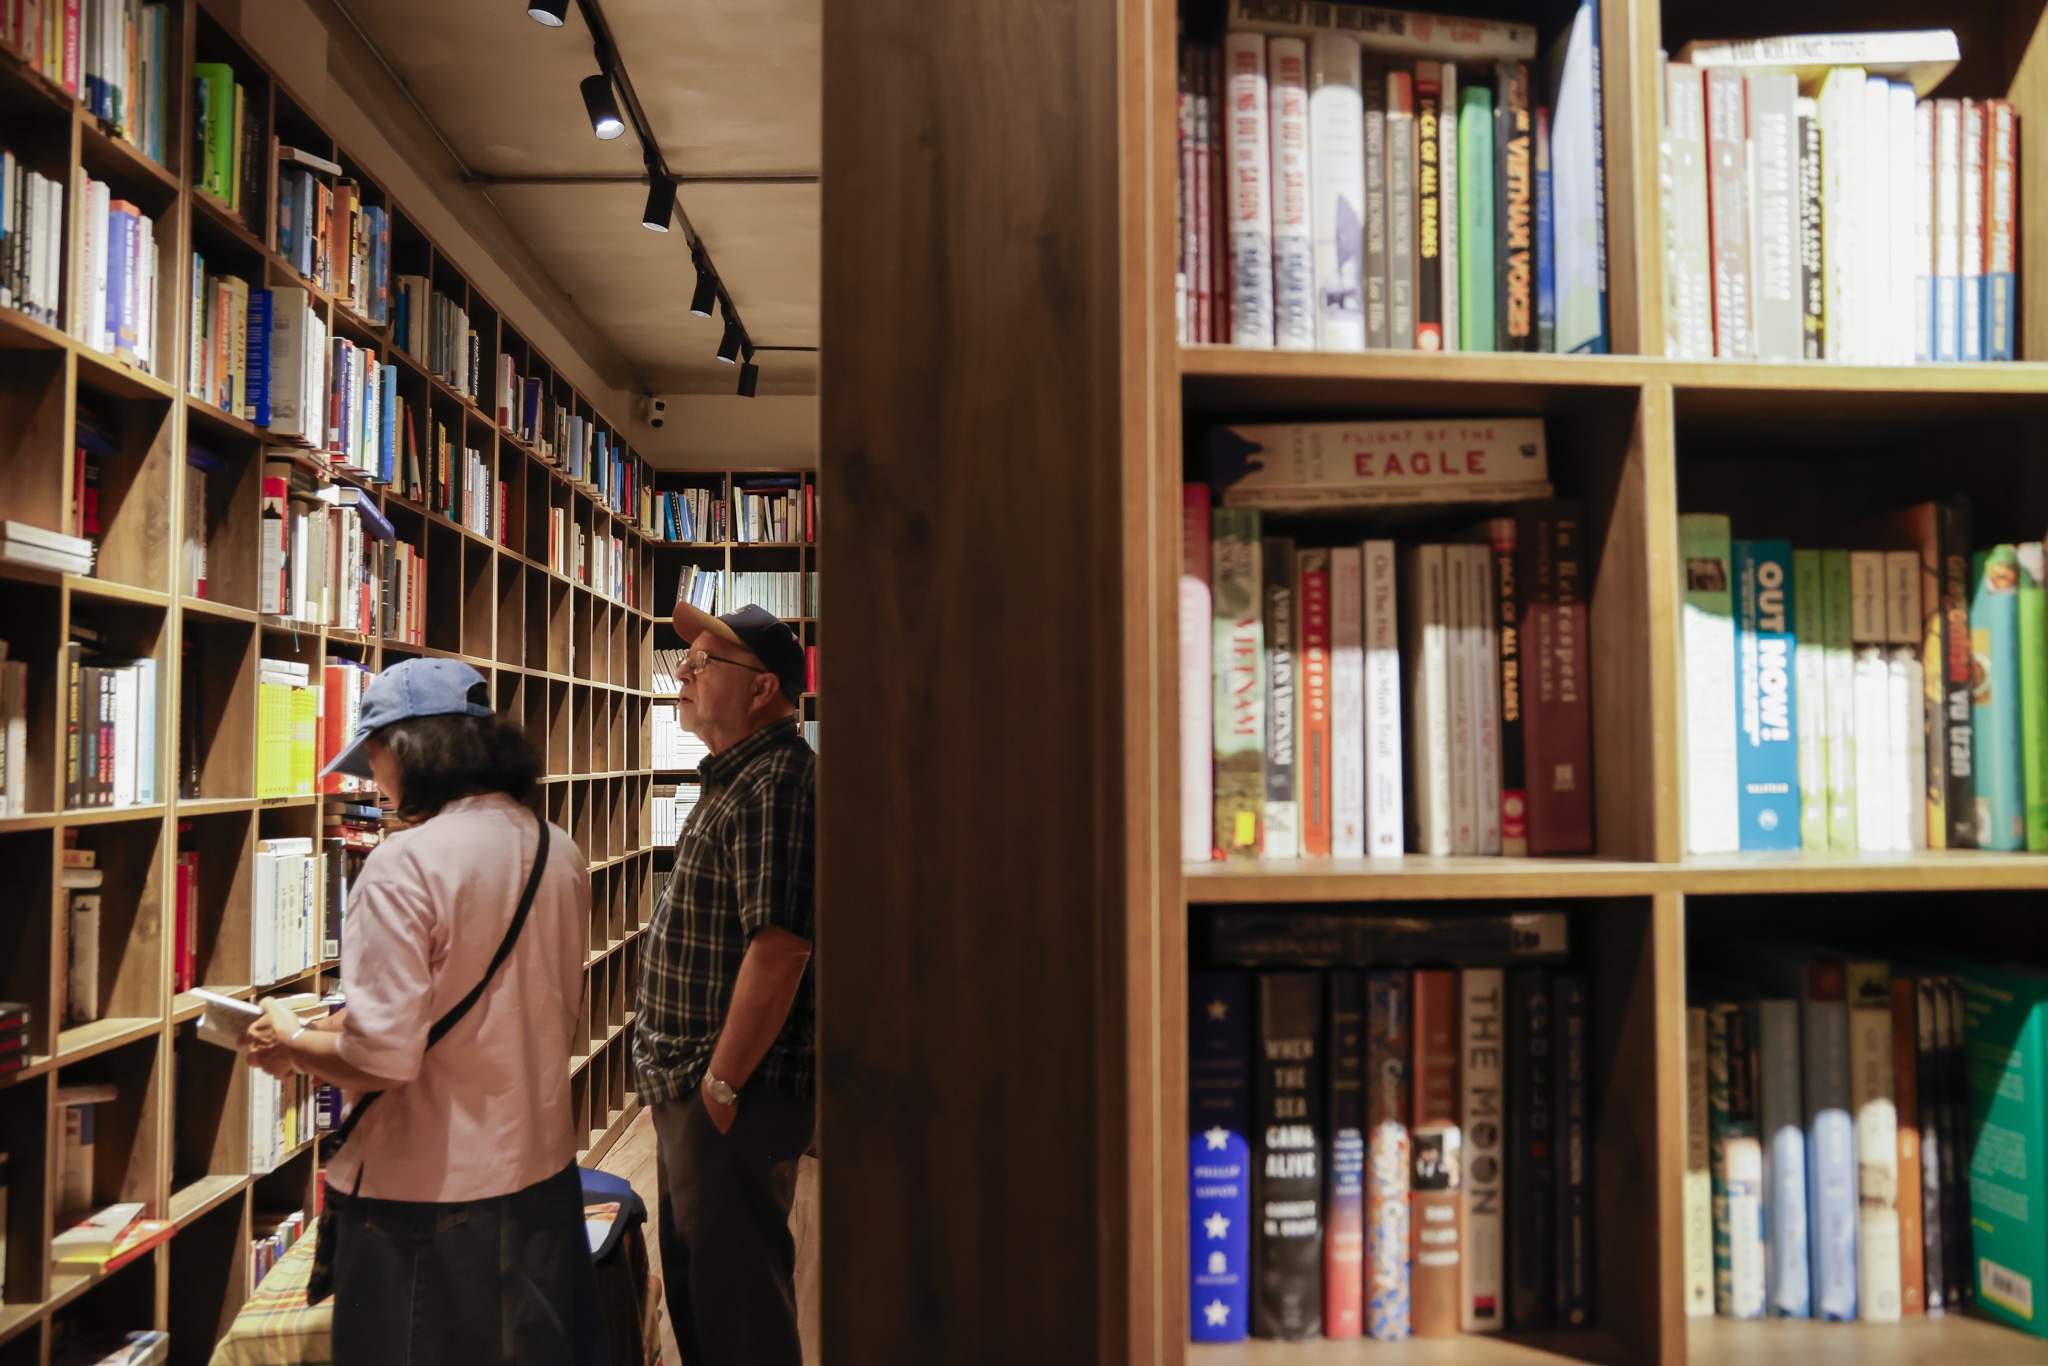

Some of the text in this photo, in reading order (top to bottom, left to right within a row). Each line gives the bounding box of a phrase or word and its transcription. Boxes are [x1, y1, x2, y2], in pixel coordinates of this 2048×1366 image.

[1236, 52, 1257, 111] GETTING
[1280, 57, 1301, 116] GETTING
[207, 119, 215, 154] YOU
[1237, 118, 1257, 143] OUT
[1282, 122, 1301, 148] OUT
[1420, 140, 1436, 164] OF
[1237, 167, 1258, 221] SAIGON
[1282, 171, 1304, 225] SAIGON
[1421, 166, 1437, 195] ALL
[1507, 136, 1529, 249] VIETNAM
[1369, 192, 1382, 254] HONOR
[1394, 196, 1408, 256] HONOR
[1421, 197, 1438, 258] TRADES
[1508, 251, 1529, 337] VOICES
[236, 309, 245, 371] CAPITAL
[1342, 428, 1496, 445] FLIGHT OF THE
[1354, 450, 1488, 478] EAGLE
[1503, 625, 1518, 658] ALL
[1555, 562, 1578, 703] Retrospect
[1945, 555, 1971, 682] dragonfish
[1233, 618, 1255, 736] VIETNAM
[1757, 560, 1790, 742] OUT NOW!
[1503, 659, 1519, 722] TRADES
[1949, 689, 1972, 777] vu tran
[1265, 1039, 1314, 1060] WHEN
[1275, 1067, 1306, 1088] THE
[1275, 1096, 1307, 1118] SEA
[1470, 988, 1499, 1215] THE MOON
[1266, 1152, 1316, 1177] ALIVE
[1375, 1200, 1405, 1289] Century
[1688, 1203, 1705, 1275] SOULS
